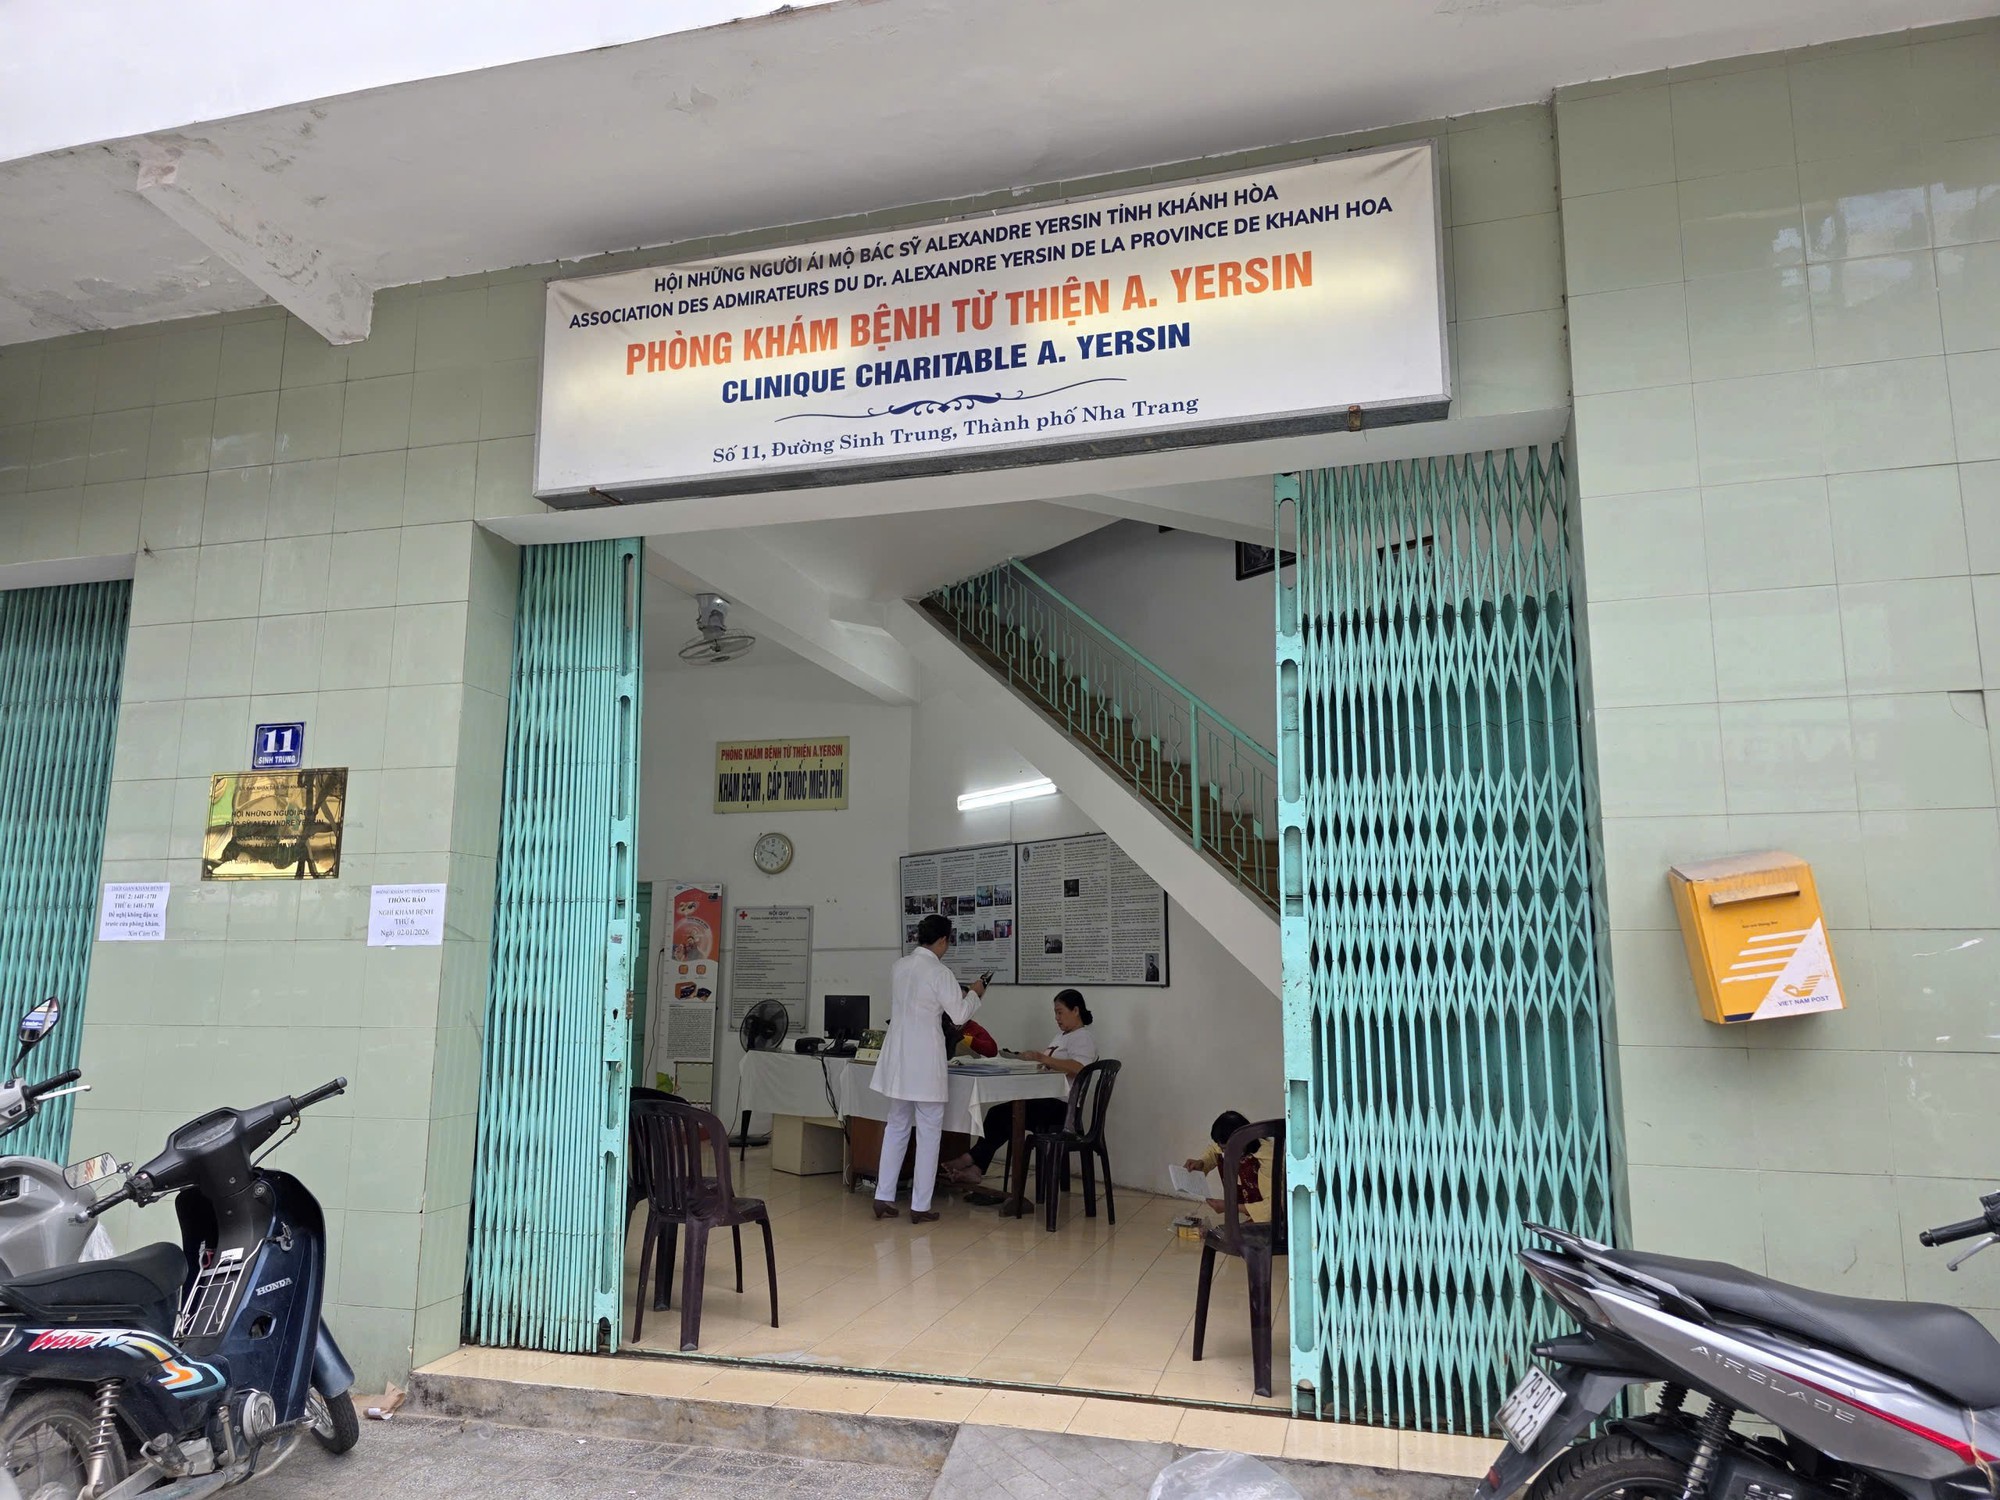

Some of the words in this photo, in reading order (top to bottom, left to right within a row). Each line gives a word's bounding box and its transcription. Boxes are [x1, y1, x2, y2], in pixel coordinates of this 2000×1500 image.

[654, 274, 684, 295] HỘI
[687, 265, 745, 290] NHỮNG
[749, 257, 802, 281] NGƯỜI
[806, 252, 824, 271] ÁI
[828, 247, 855, 270] MỘ
[860, 242, 894, 264] BÁC
[899, 236, 922, 257] SỸ
[925, 222, 1031, 254] ALEXANDRE
[1035, 212, 1102, 237] YERSIN
[1107, 203, 1152, 226] TỈNH
[1158, 191, 1229, 218] KHÁNH
[1234, 184, 1278, 206] HÒA
[569, 303, 674, 329] ASSOCIATION
[678, 298, 708, 315] DES
[713, 280, 829, 311] ADMIRATEURS
[834, 277, 859, 294] DU
[864, 272, 888, 290] Dr.
[891, 255, 997, 285] ALEXANDRE
[1001, 244, 1066, 271] YERSIN
[1071, 240, 1096, 258] DE
[1101, 236, 1126, 254] LA
[1131, 221, 1229, 250] PROVINCE
[1234, 216, 1261, 236] DE
[1265, 204, 1340, 230] KHANH
[1345, 196, 1393, 218] HOA
[626, 328, 732, 376] PHÒNG
[744, 314, 838, 361] KHÁM
[851, 303, 940, 351] BỆNH
[952, 288, 998, 332] TỪ
[1005, 276, 1110, 326] THIỆN
[1123, 274, 1158, 312] A.
[1170, 250, 1313, 305] YERSIN
[722, 367, 846, 404] CLINIQUE
[855, 343, 1027, 388] CHARITABLE
[1037, 340, 1067, 365] A.
[1076, 322, 1191, 360] YERSIN
[713, 445, 738, 463] Số
[741, 444, 767, 462] 11,
[771, 436, 835, 458] Đường
[839, 431, 885, 451] Sinh
[890, 424, 958, 445] Trung,
[963, 415, 1030, 436] Thành
[1036, 407, 1077, 431] phố
[1083, 405, 1126, 422] Nha
[1132, 398, 1199, 418] Trang
[263, 728, 294, 753] 11
[721, 746, 743, 760] PHÒNG
[744, 745, 763, 760] KHÁM
[764, 745, 782, 761] BỆNH
[783, 743, 792, 758] TỪ
[793, 744, 811, 760] THIỆN
[258, 756, 274, 764] SINH
[275, 755, 296, 763] TRUNG
[718, 766, 740, 802] KHÁM
[741, 766, 762, 808] BỆNH
[767, 760, 782, 801] CẤP
[784, 759, 807, 800] THUỐC
[808, 759, 828, 799] MIỄN
[830, 762, 844, 799] PHÍ
[232, 810, 244, 818] HỘI
[388, 896, 411, 904] THÔNG
[412, 895, 426, 903] BÁO
[380, 929, 395, 937] Ngày
[1778, 999, 1793, 1007] VIET
[1794, 997, 1810, 1005] NAM
[255, 1277, 293, 1296] HONDA
[1690, 1345, 1856, 1424] AIRBLADE
